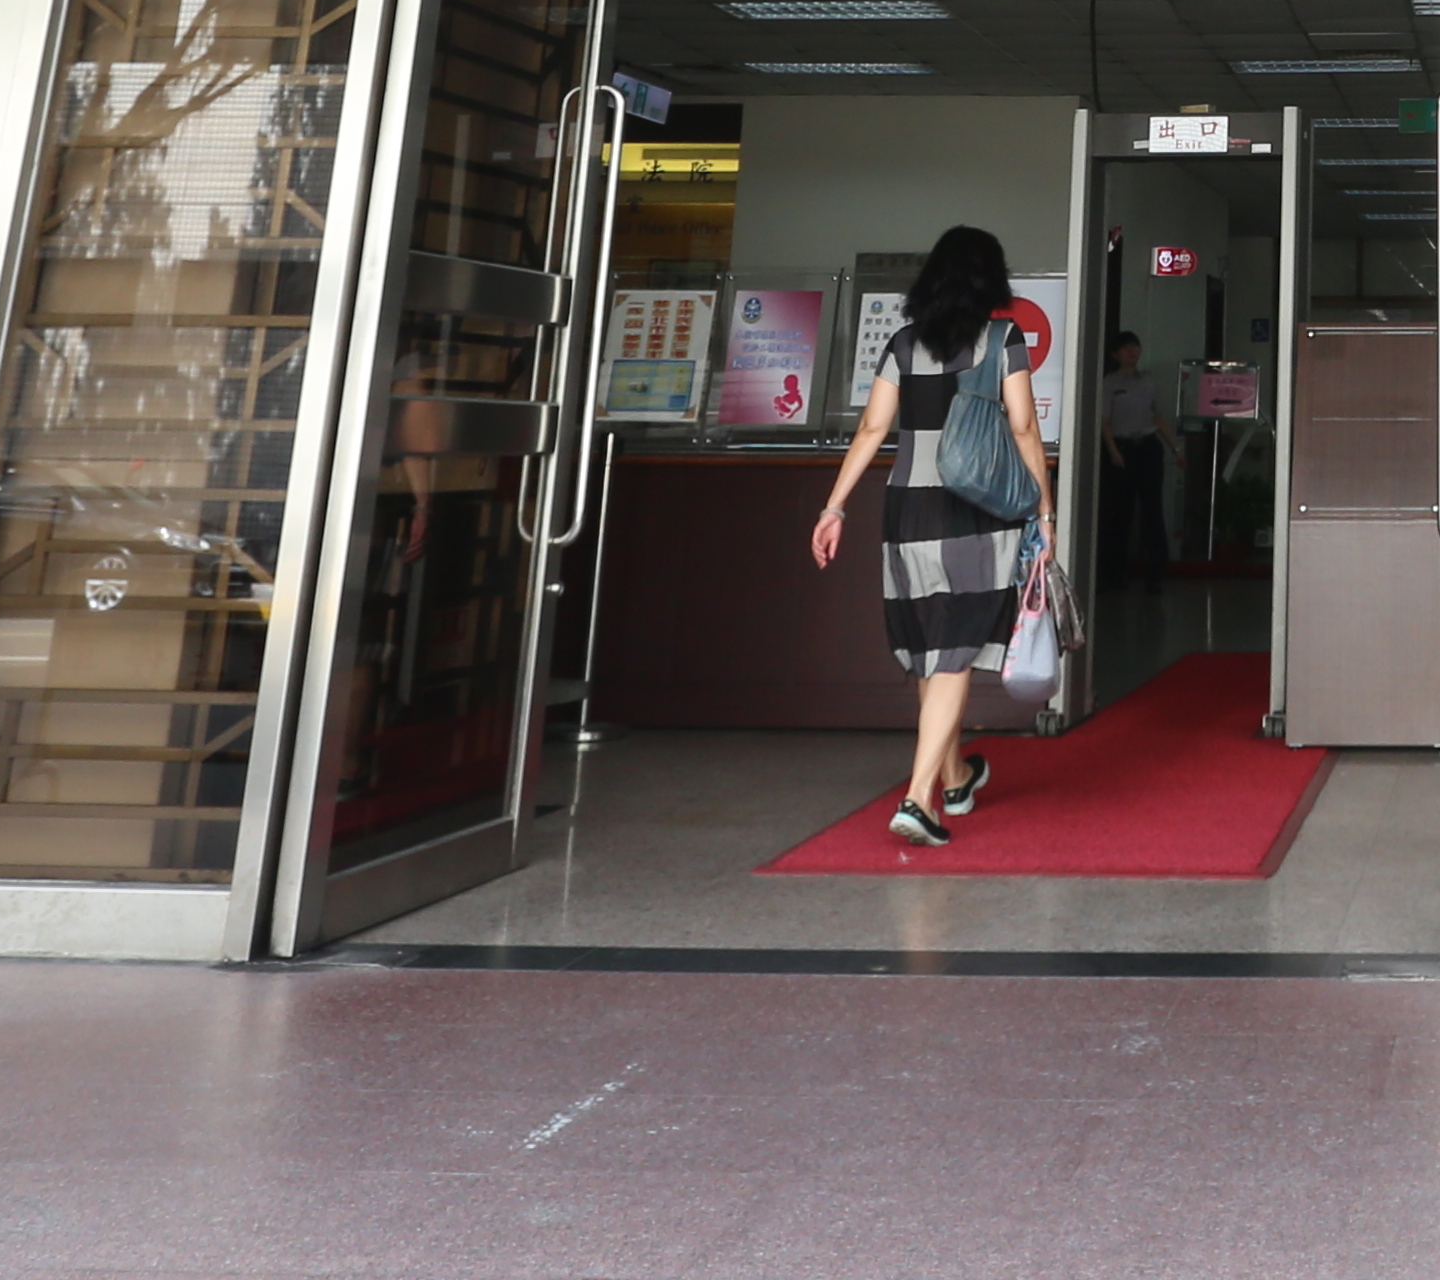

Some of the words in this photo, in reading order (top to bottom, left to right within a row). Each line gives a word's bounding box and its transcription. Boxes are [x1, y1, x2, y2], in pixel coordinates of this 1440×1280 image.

[1159, 120, 1219, 138] 出口
[1175, 139, 1203, 150] Exit
[1173, 254, 1191, 263] AED
